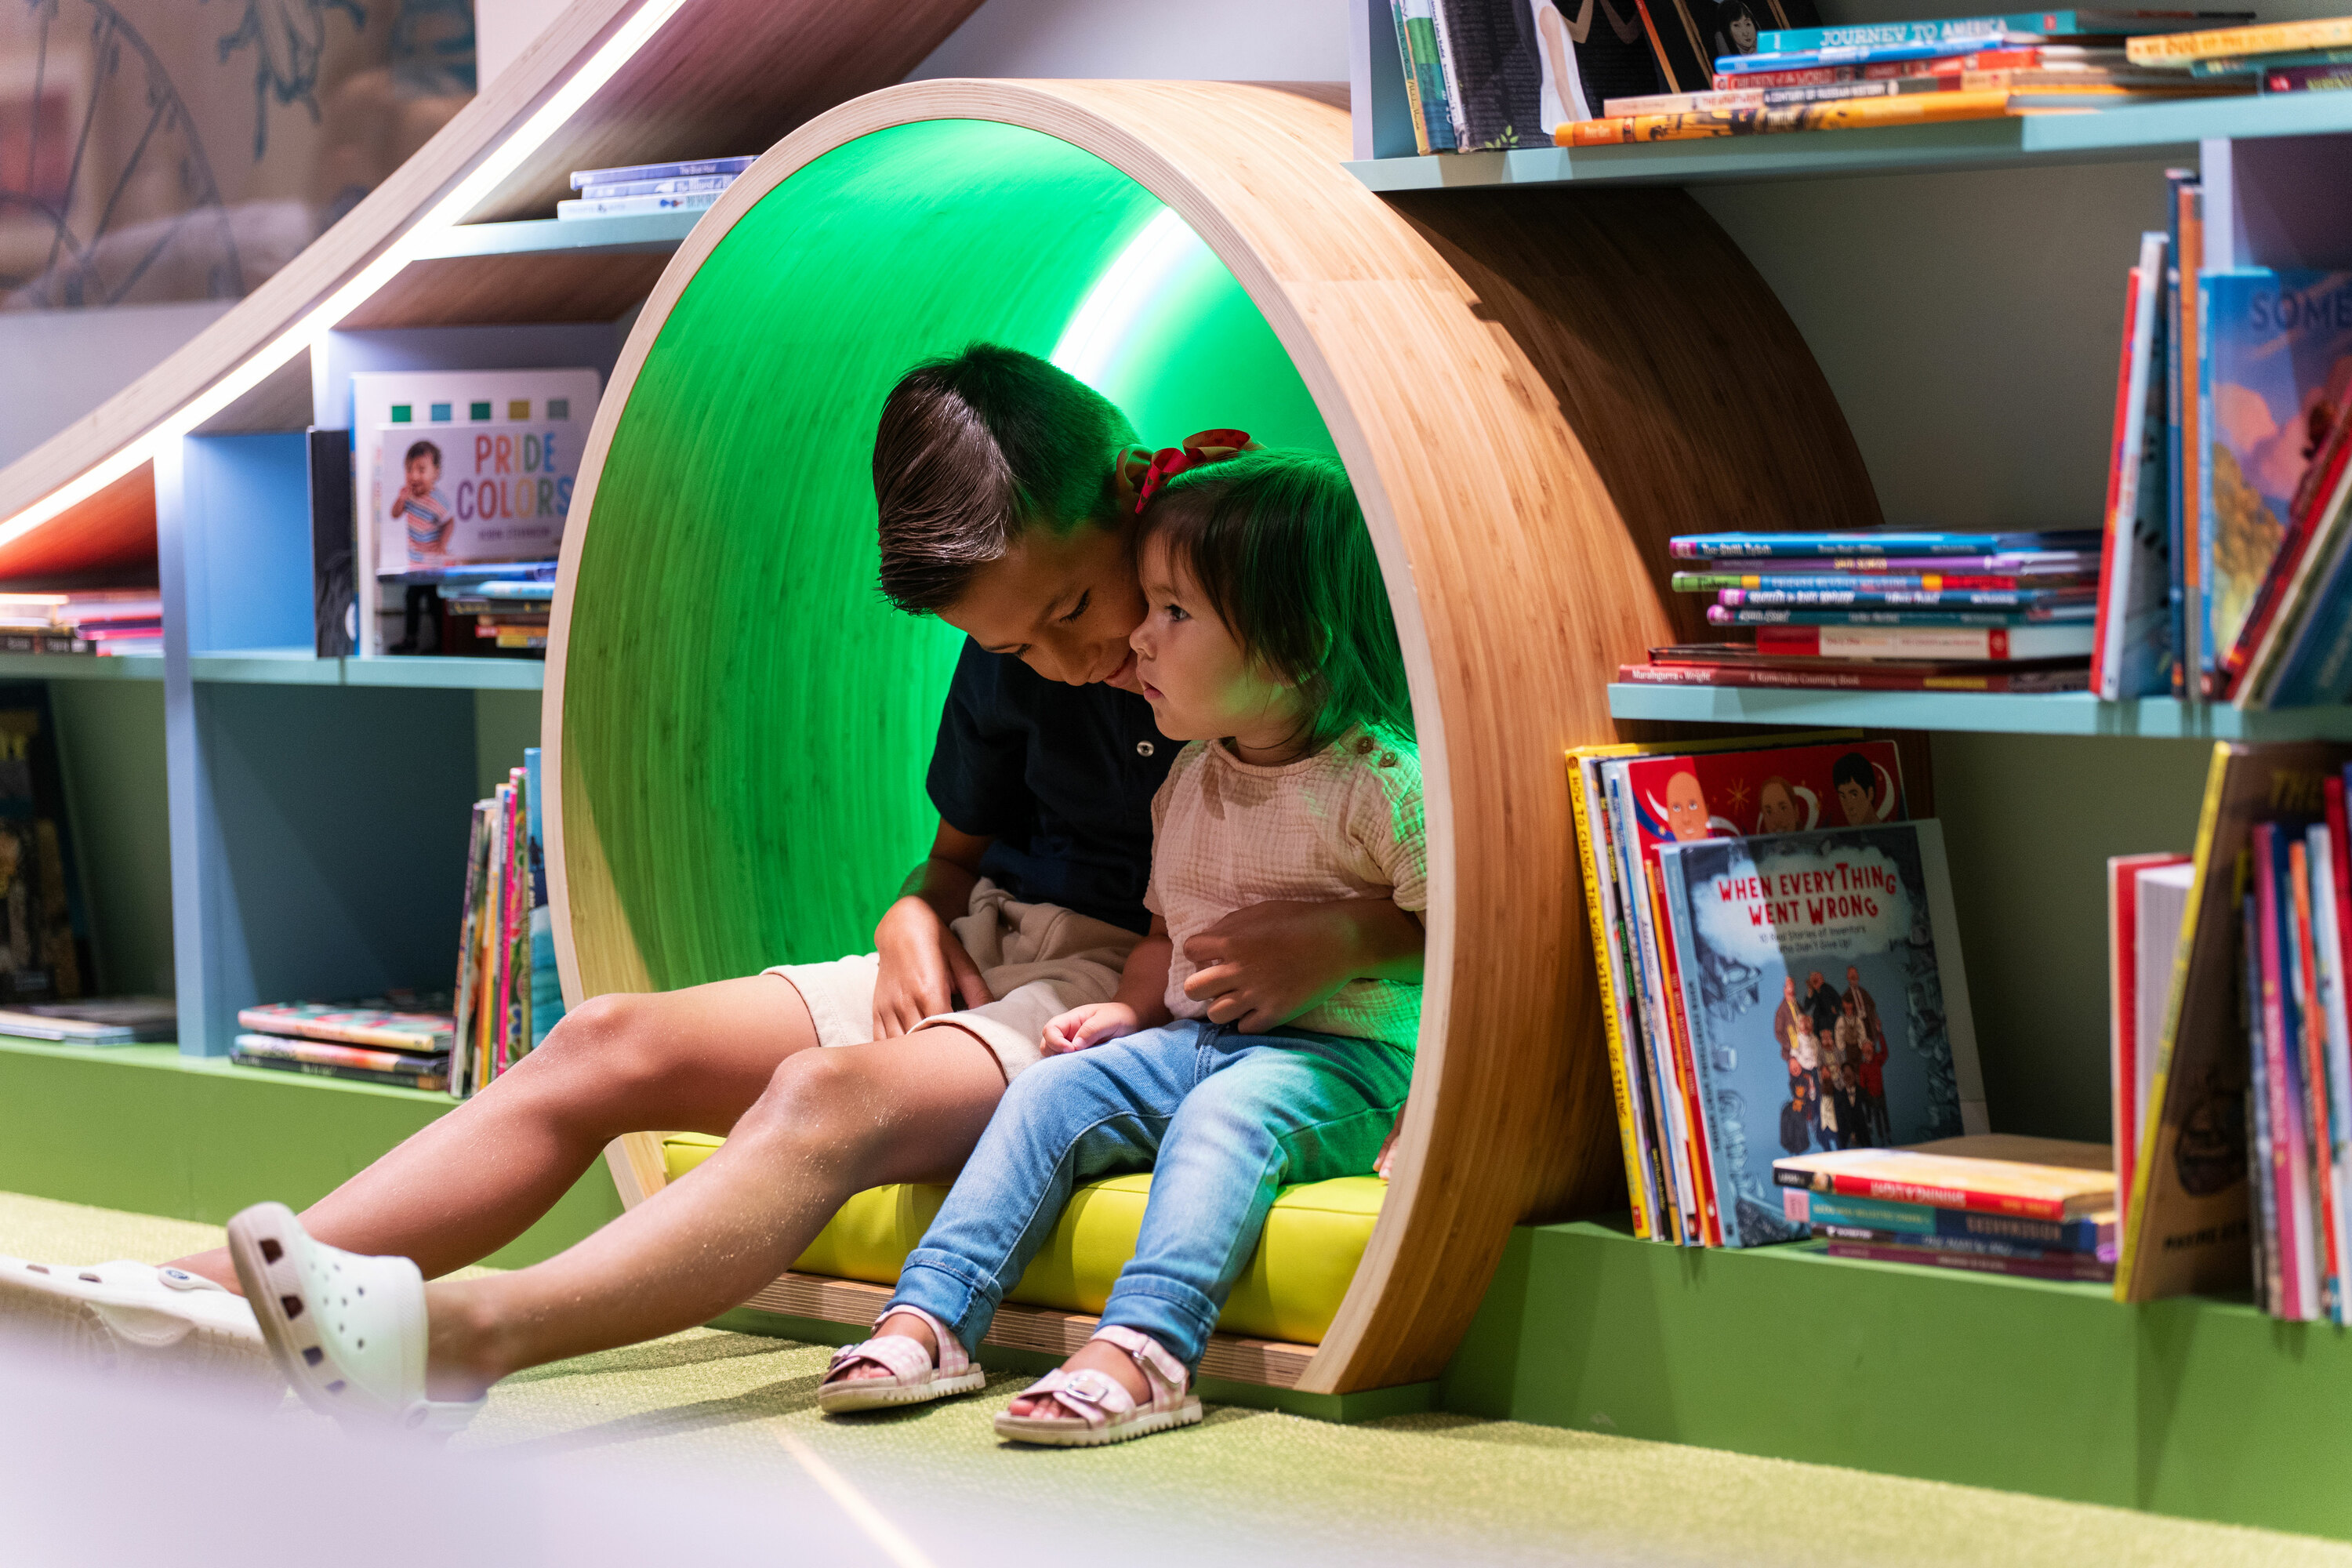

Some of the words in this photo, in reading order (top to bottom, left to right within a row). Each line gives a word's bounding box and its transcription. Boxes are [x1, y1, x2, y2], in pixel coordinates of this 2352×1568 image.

[1820, 27, 1907, 46] JOURNEY
[1911, 24, 1937, 41] TO
[474, 433, 557, 474] PRIDE
[456, 475, 574, 523] COLORS
[1719, 542, 1744, 556] Small
[1684, 670, 1711, 683] Wright
[1570, 776, 1580, 803] HOW
[1577, 809, 1585, 826] TO
[1580, 830, 1592, 881] CHANGE
[1718, 875, 1773, 902] WHEN
[1779, 862, 1896, 895] EVERYTHING
[1585, 886, 1598, 913] THE
[1748, 901, 1799, 927] WENT
[1806, 893, 1878, 926] WRONG
[1589, 917, 1605, 958] WORLD
[1624, 903, 1639, 961] WOOD
[1788, 929, 1817, 942] Stories
[1818, 927, 1828, 938] of
[1828, 925, 1867, 937] Inventors
[1819, 939, 1837, 950] Give
[1641, 922, 1655, 975] AMAZING
[1596, 961, 1609, 998] WITH
[1605, 1014, 1617, 1043] BALL
[1610, 1047, 1620, 1063] OF
[1612, 1068, 1628, 1119] STRING
